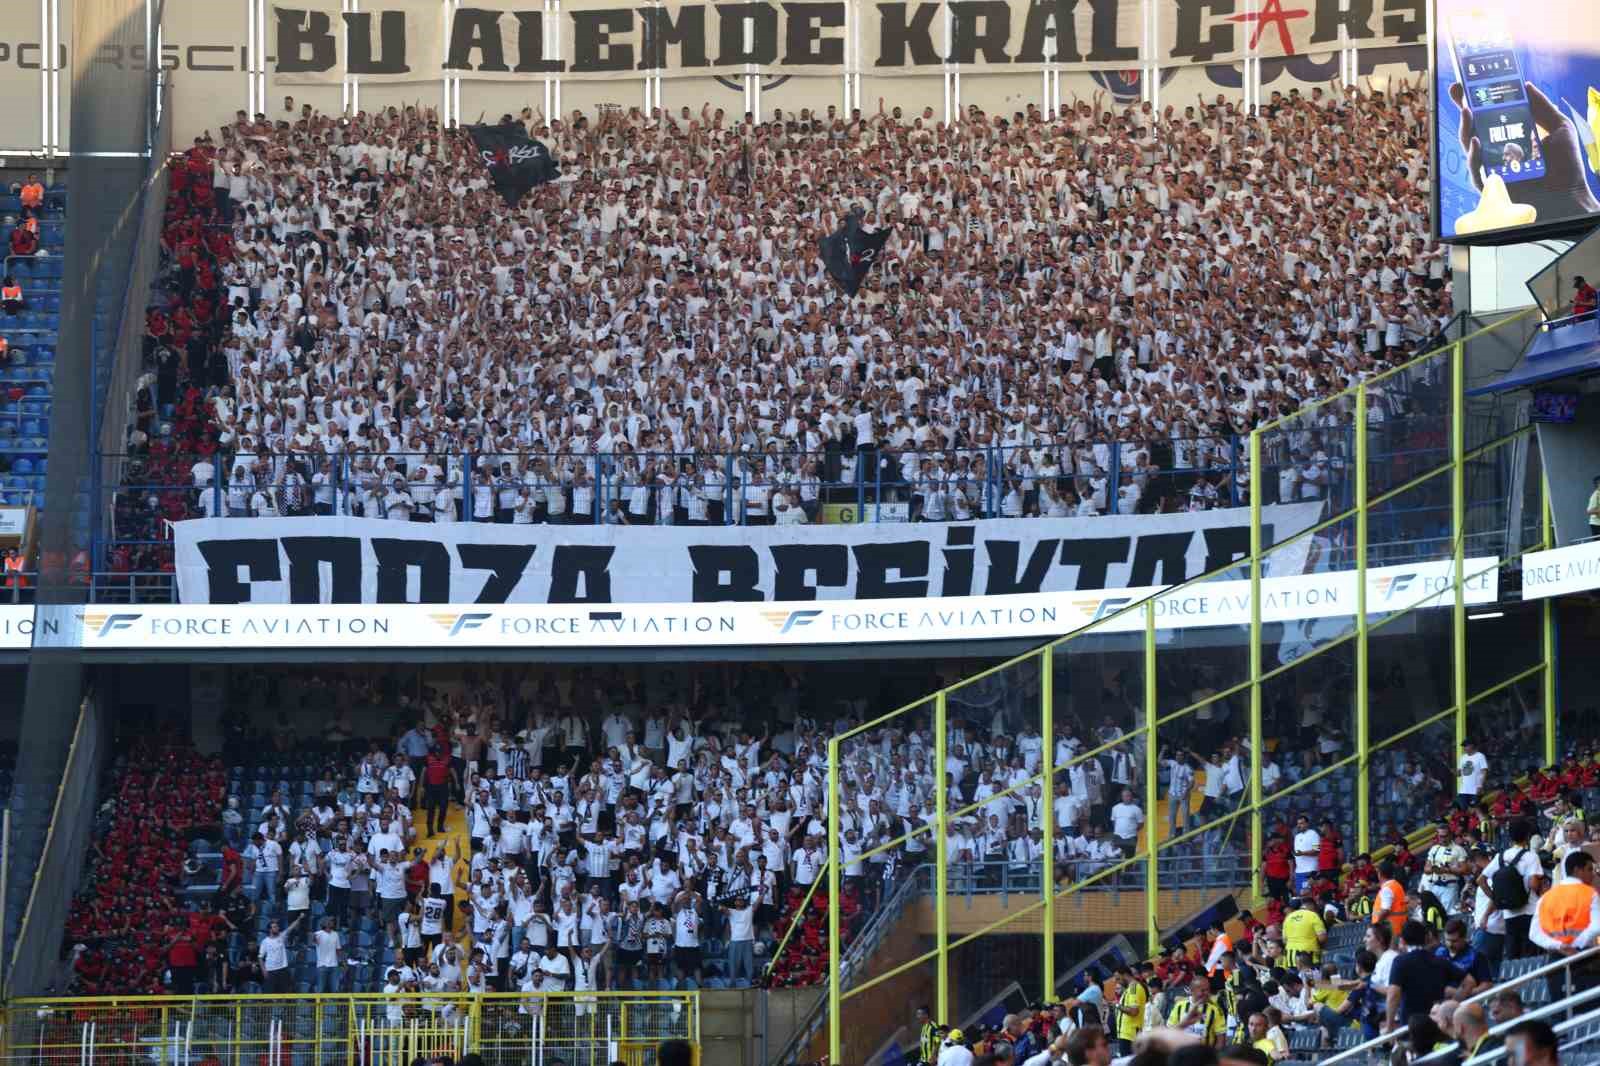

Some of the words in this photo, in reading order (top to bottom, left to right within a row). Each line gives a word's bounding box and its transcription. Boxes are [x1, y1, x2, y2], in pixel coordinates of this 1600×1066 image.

[274, 7, 410, 73] BU
[442, 2, 845, 71] ALEMDE
[875, 0, 1139, 67] KRAL
[1424, 571, 1489, 594] FOCE
[1217, 587, 1338, 612] AVATION
[151, 618, 231, 635] FORCE
[242, 618, 389, 635] AVIATION
[500, 617, 580, 634] FORCE
[589, 615, 735, 634] AVIATION
[831, 611, 909, 631] FORCE
[918, 606, 1057, 628] AVIATION
